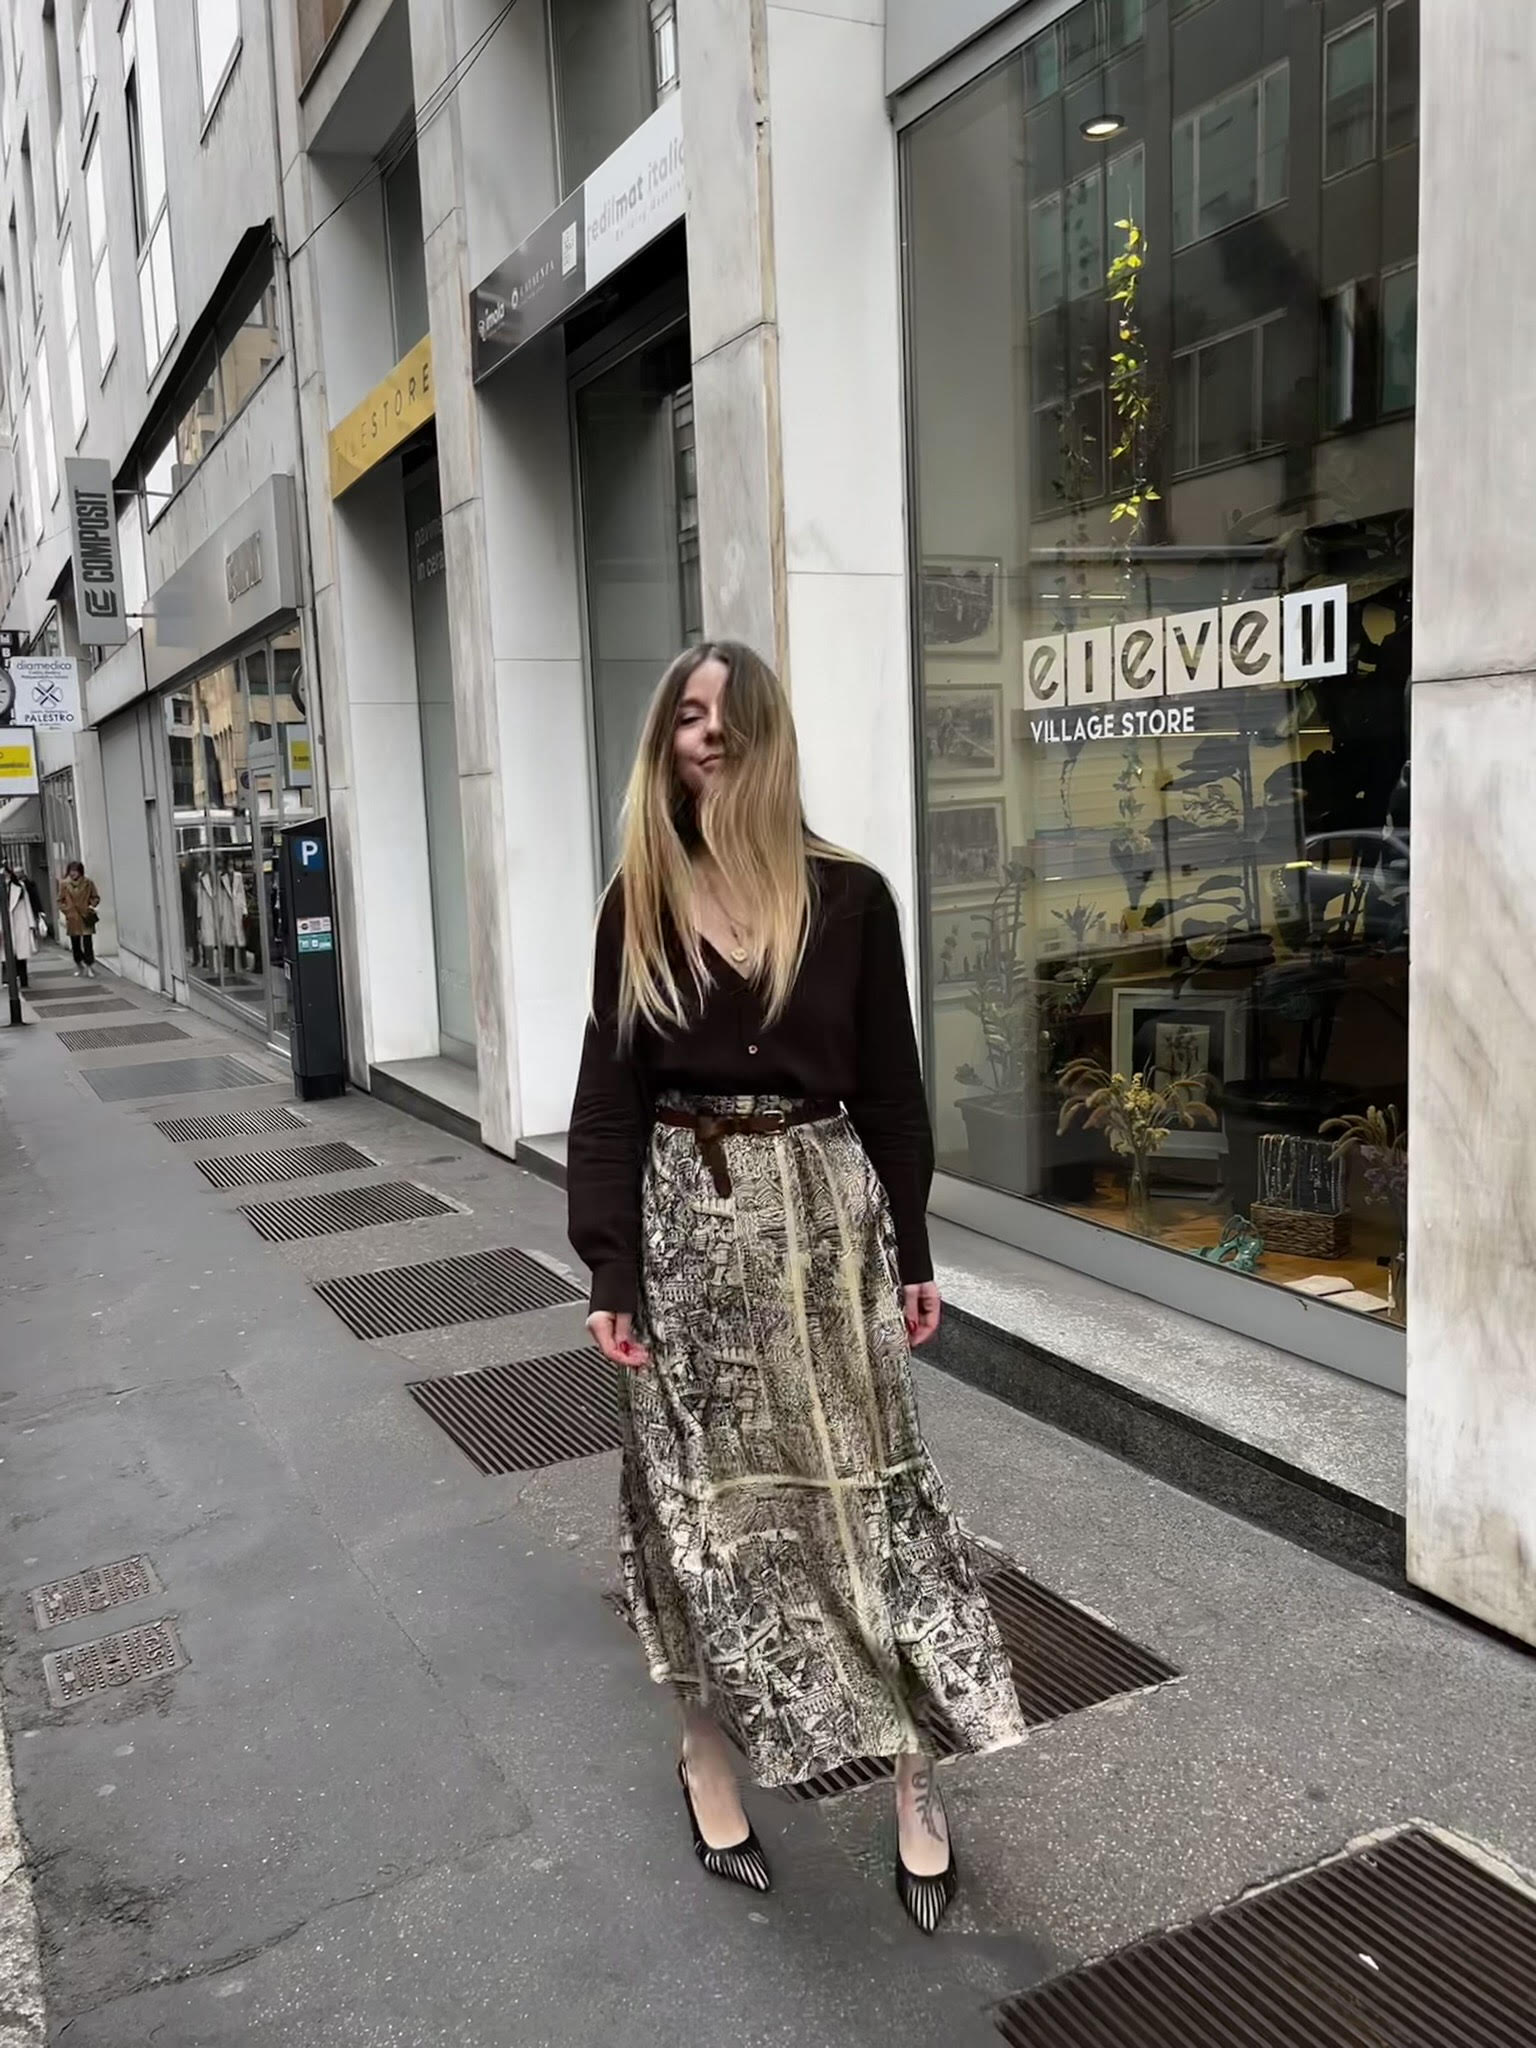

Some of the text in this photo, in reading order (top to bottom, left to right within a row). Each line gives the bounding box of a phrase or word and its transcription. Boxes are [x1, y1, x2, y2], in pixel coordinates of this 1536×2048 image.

[74, 489, 115, 583] COMPOSIT
[24, 713, 75, 723] PALESTRO
[1030, 706, 1195, 744] VILLAGE STORE
[301, 840, 319, 866] P
